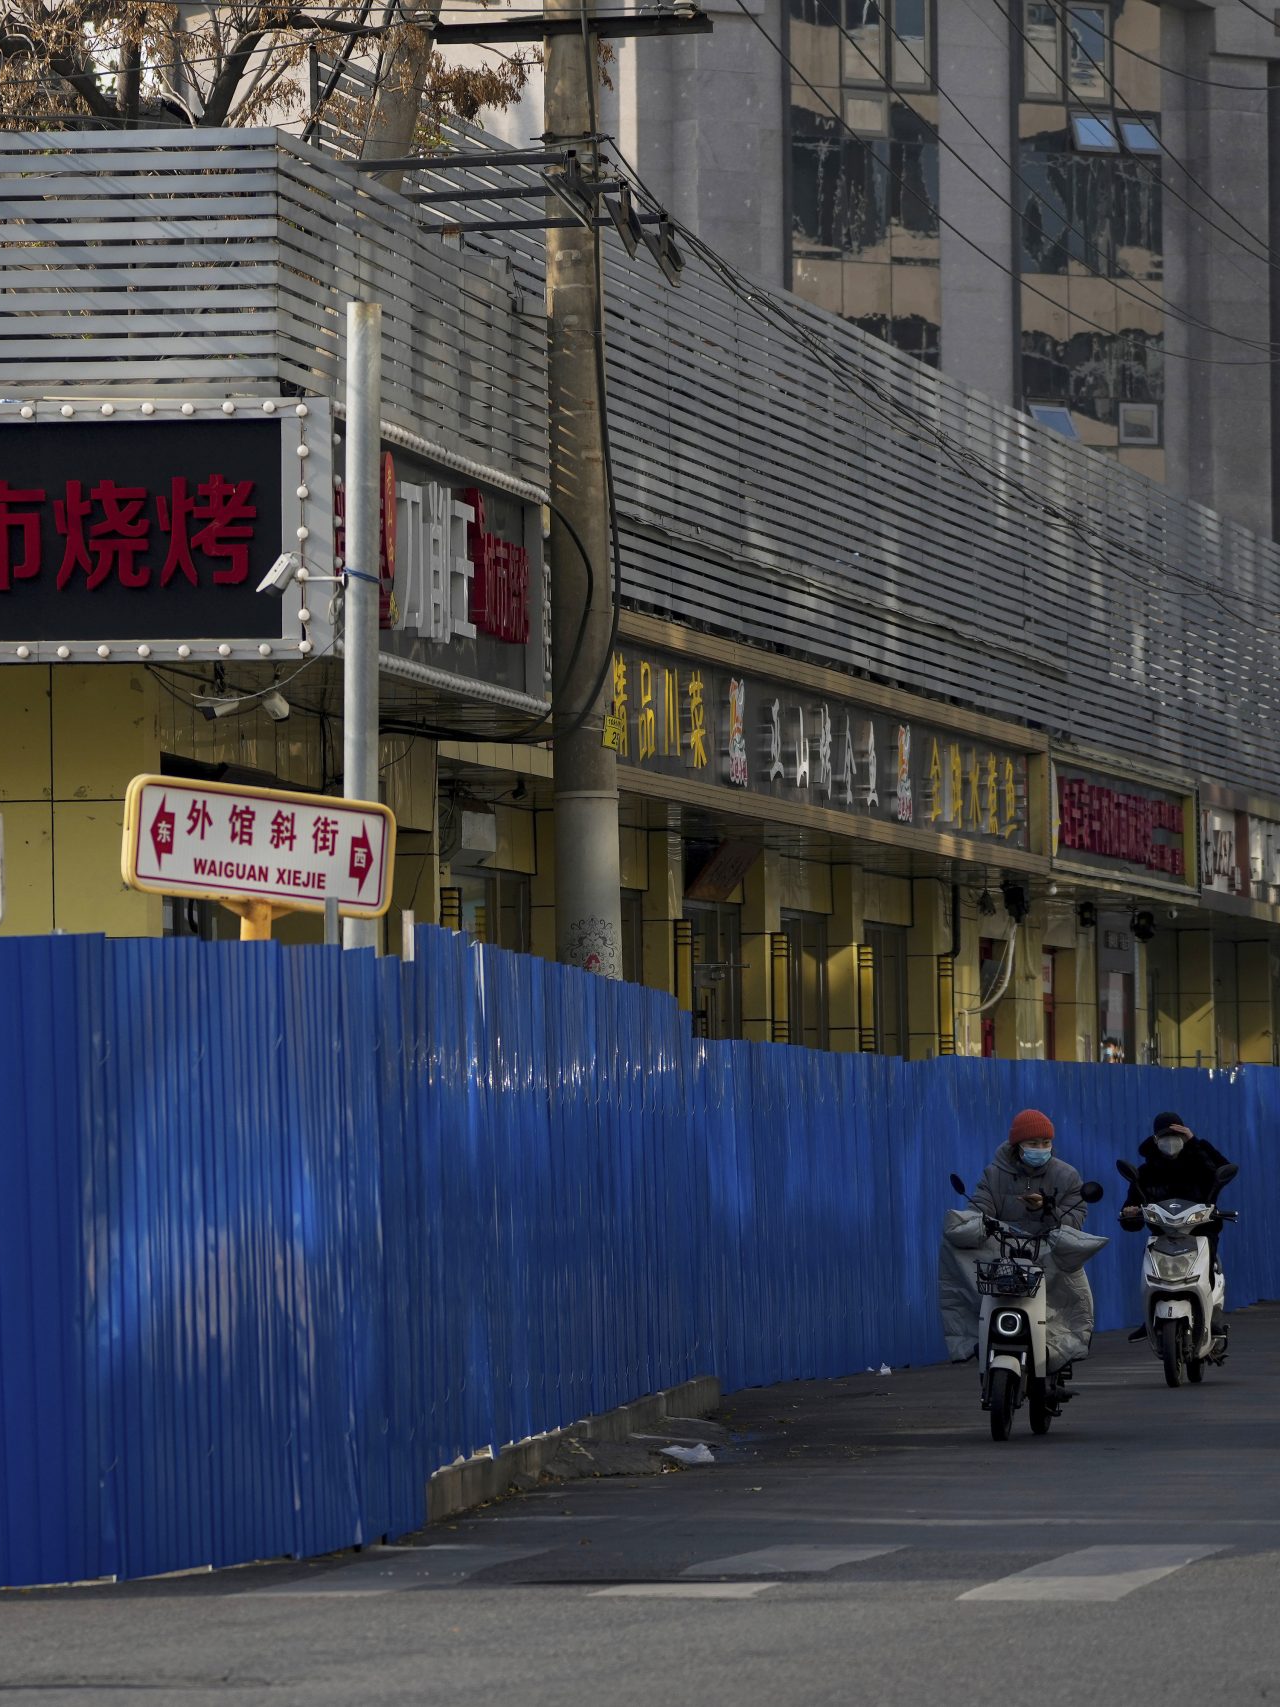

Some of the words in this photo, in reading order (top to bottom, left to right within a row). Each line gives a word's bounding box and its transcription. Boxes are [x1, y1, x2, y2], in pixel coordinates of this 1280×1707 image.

[156, 820, 172, 844] 东
[186, 799, 339, 856] 外馆斜街
[353, 846, 367, 869] 西
[193, 857, 269, 883] WAIGUAN
[275, 867, 327, 890] XIEJIE
